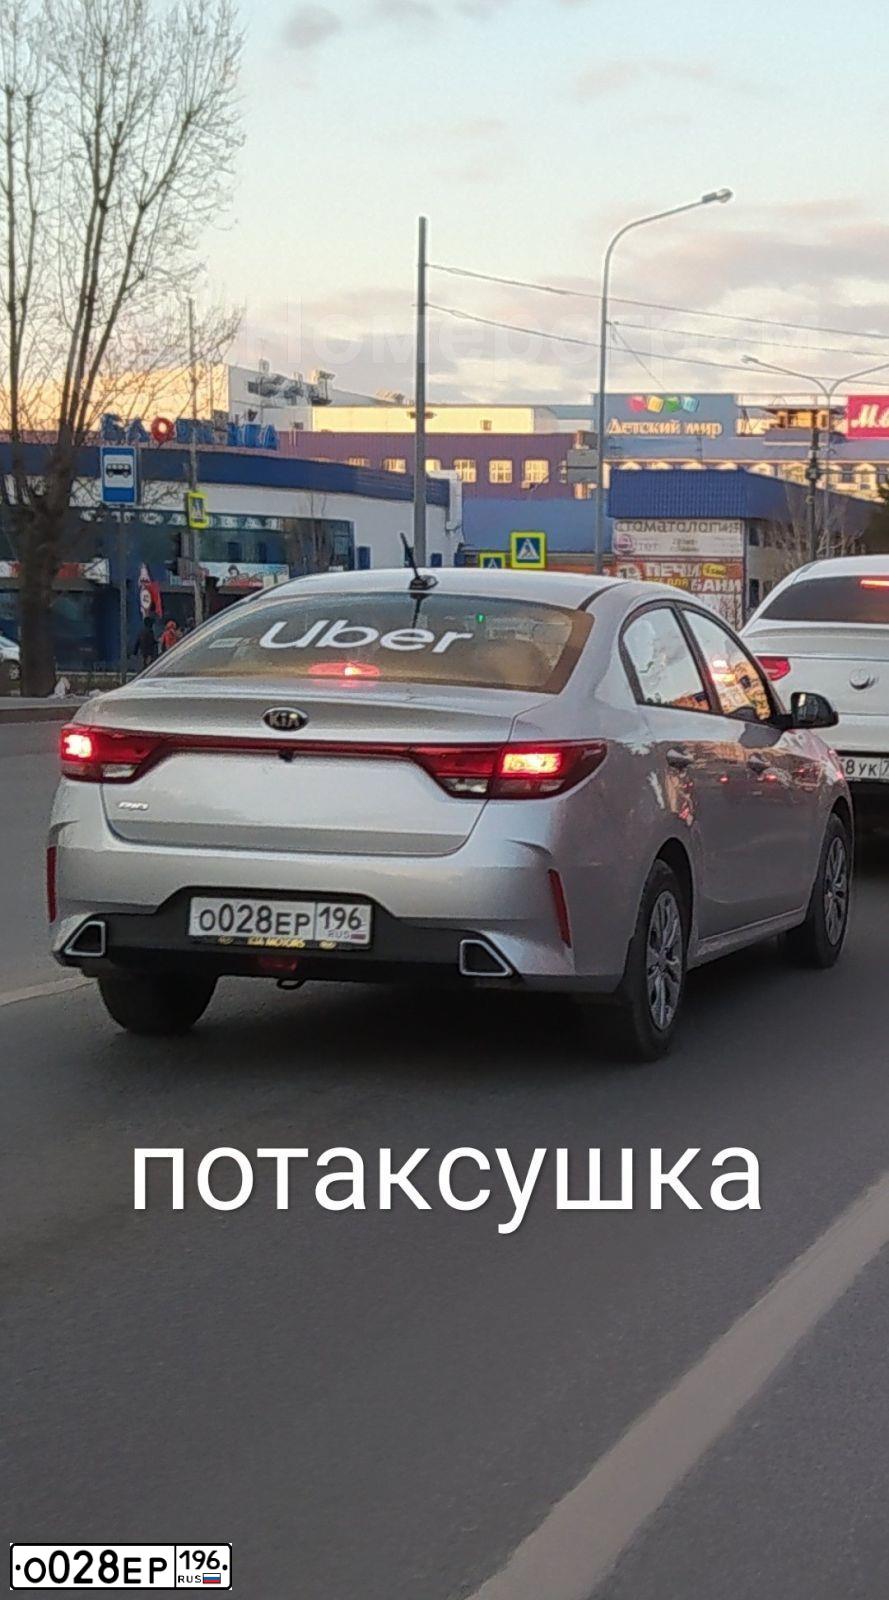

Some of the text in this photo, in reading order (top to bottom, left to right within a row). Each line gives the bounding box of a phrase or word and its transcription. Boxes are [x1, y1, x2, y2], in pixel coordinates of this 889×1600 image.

[607, 416, 681, 435] Детский
[686, 421, 723, 438] мир
[258, 619, 473, 654] Uber
[841, 758, 878, 777] 8УК
[318, 906, 362, 931] 196
